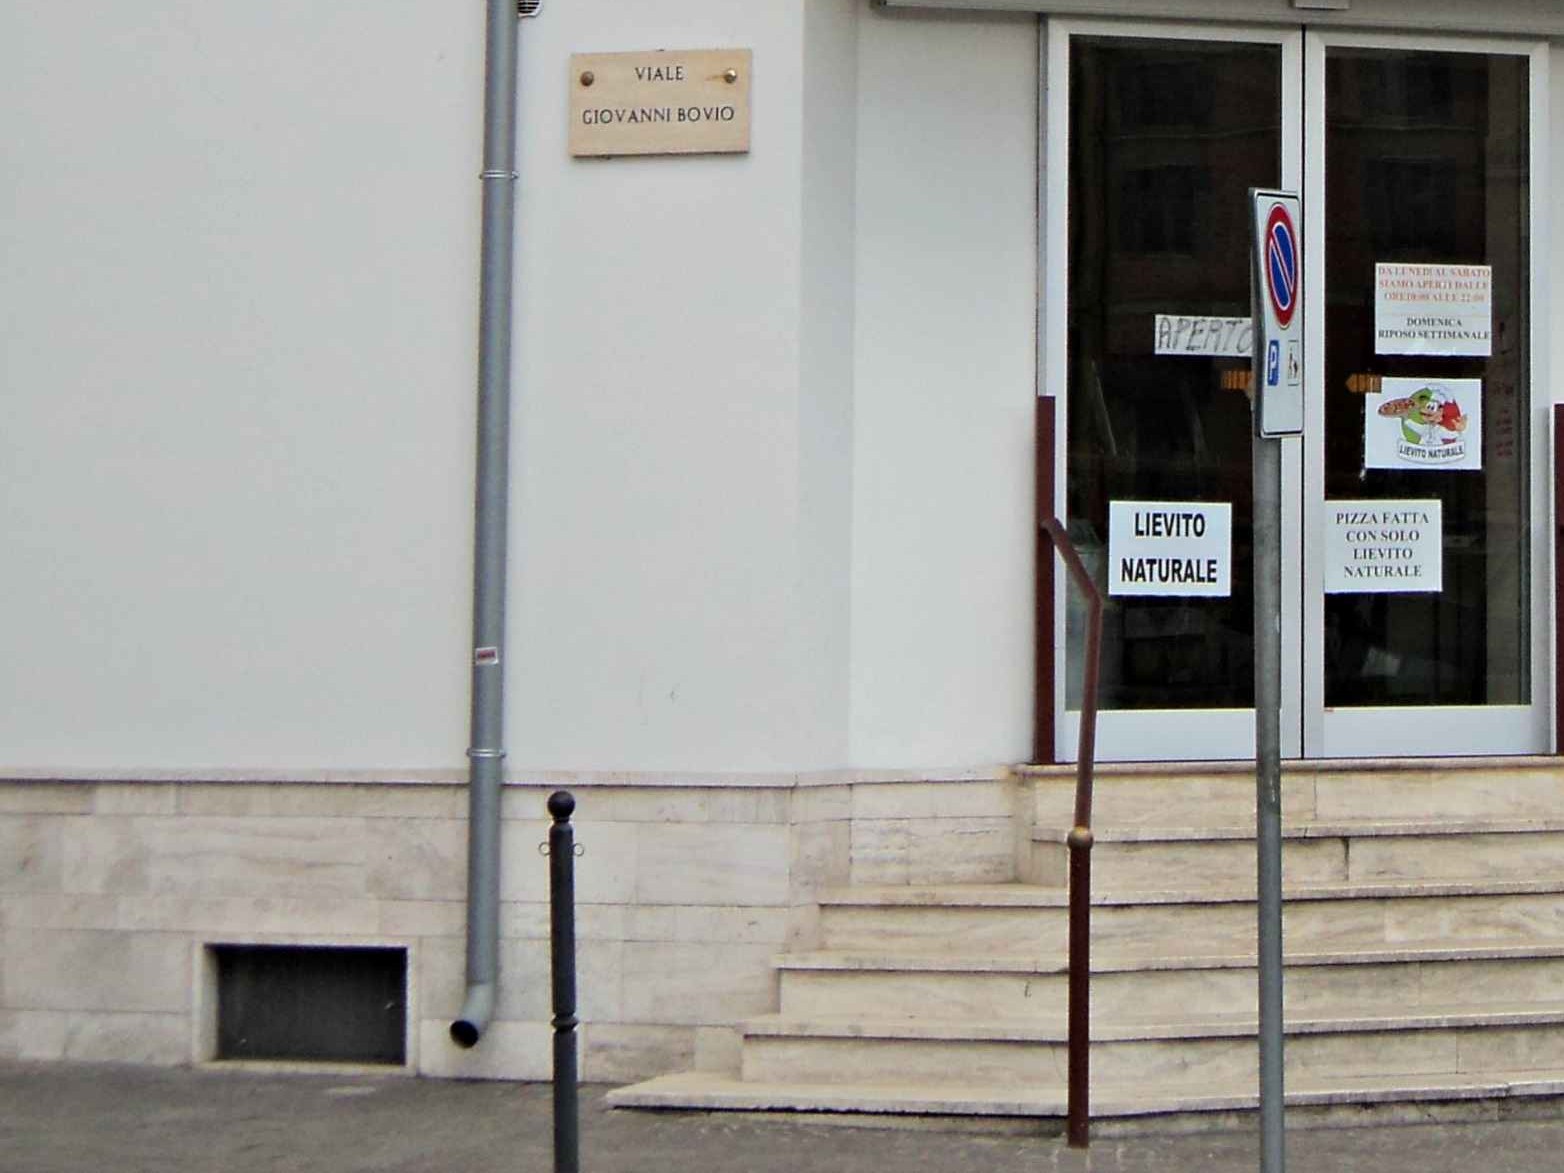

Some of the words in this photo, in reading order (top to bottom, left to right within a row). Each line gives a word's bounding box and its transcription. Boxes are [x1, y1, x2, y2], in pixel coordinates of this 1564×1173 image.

[635, 66, 685, 82] VIALE
[582, 107, 671, 125] GIOVANNI
[677, 105, 735, 123] BOVIO
[1406, 318, 1463, 328] DOMENICA
[1336, 512, 1377, 525] PIZZA
[1382, 512, 1429, 524] FATTA
[1135, 513, 1206, 538] LIEVITO
[1346, 530, 1378, 543] CON
[1381, 530, 1420, 542] SOLO
[1353, 548, 1413, 560] LIEVITO
[1121, 558, 1218, 584] NATURALE
[1344, 566, 1423, 579] NATURALE
